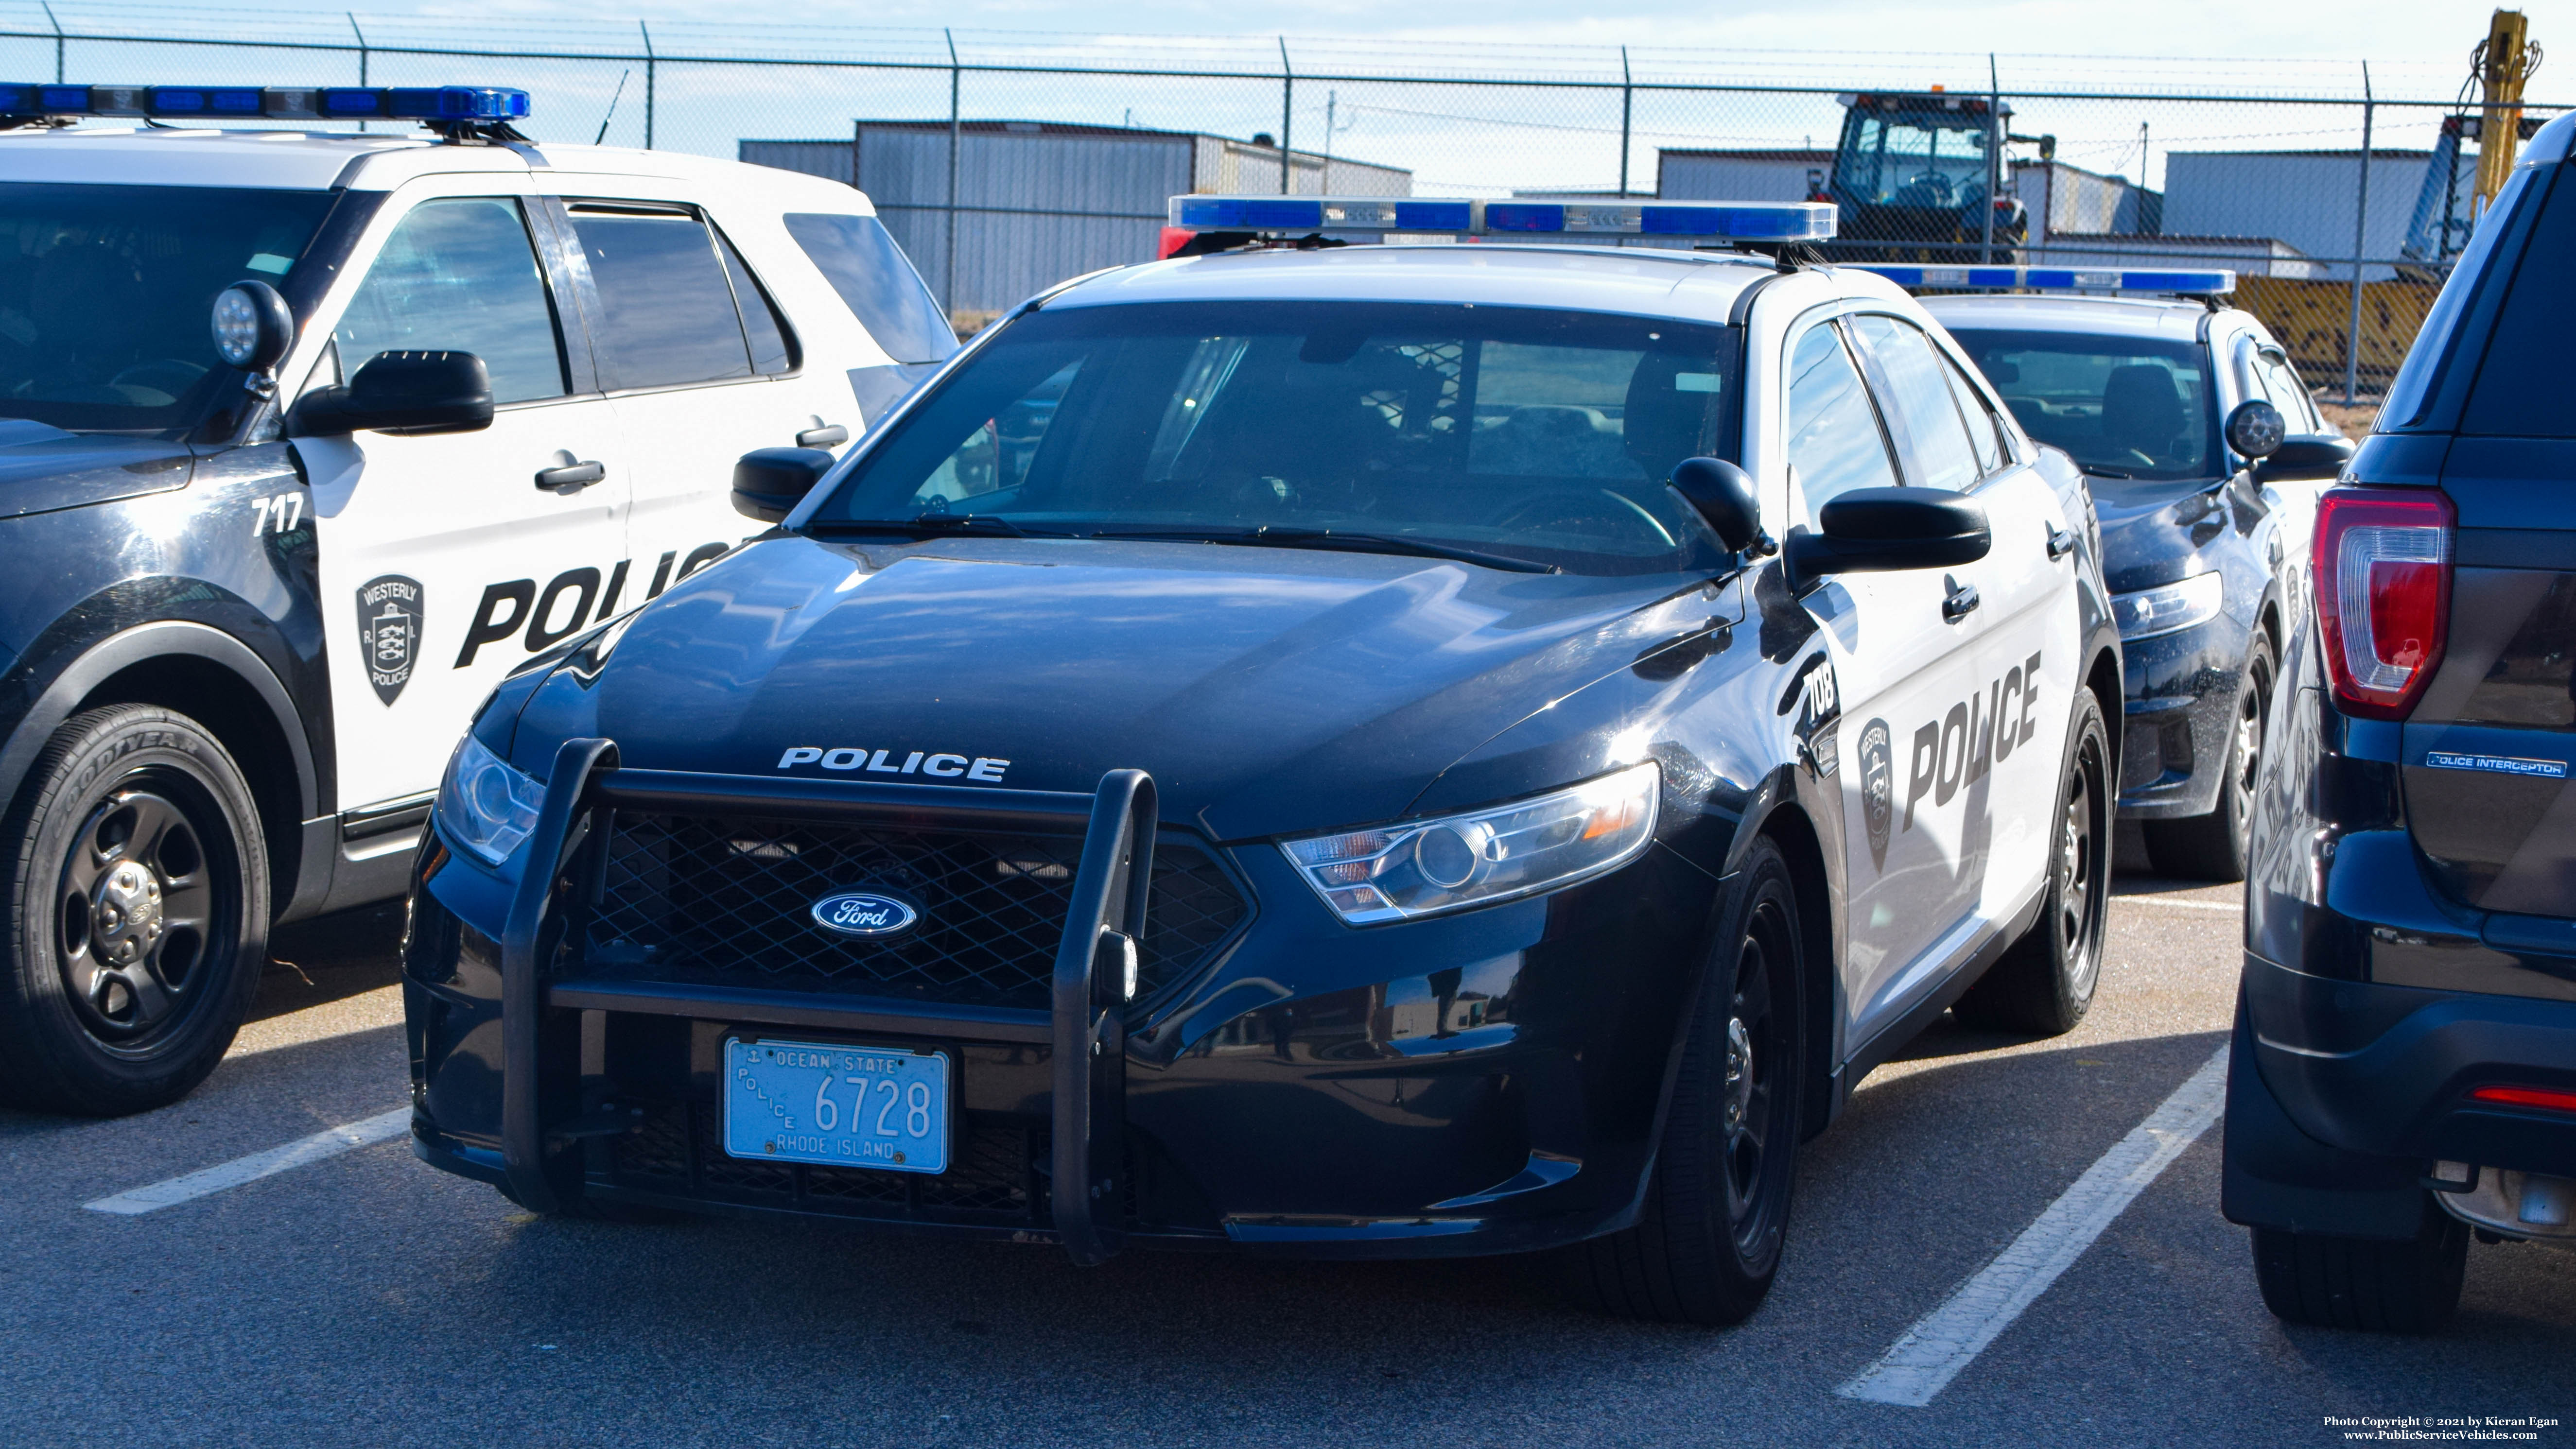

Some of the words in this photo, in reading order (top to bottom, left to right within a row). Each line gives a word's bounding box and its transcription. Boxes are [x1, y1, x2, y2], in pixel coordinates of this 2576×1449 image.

[252, 492, 304, 537] 717
[364, 583, 417, 606] WESTERLY
[453, 536, 757, 669] POLI
[373, 667, 409, 686] POLICE
[1803, 662, 1834, 721] 708
[1861, 727, 1886, 760] WESTERLY
[1902, 650, 2041, 833] POLICE
[778, 747, 1010, 782] POLICE
[2477, 759, 2562, 774] INTERCEPTOR
[833, 900, 890, 926] Ford
[777, 1052, 831, 1069] OCEAN
[845, 1058, 895, 1074] STATE
[738, 1068, 796, 1129] POLICE
[815, 1075, 931, 1138] 6728
[777, 1134, 827, 1154] RHODE
[837, 1140, 894, 1159] ISLAND
